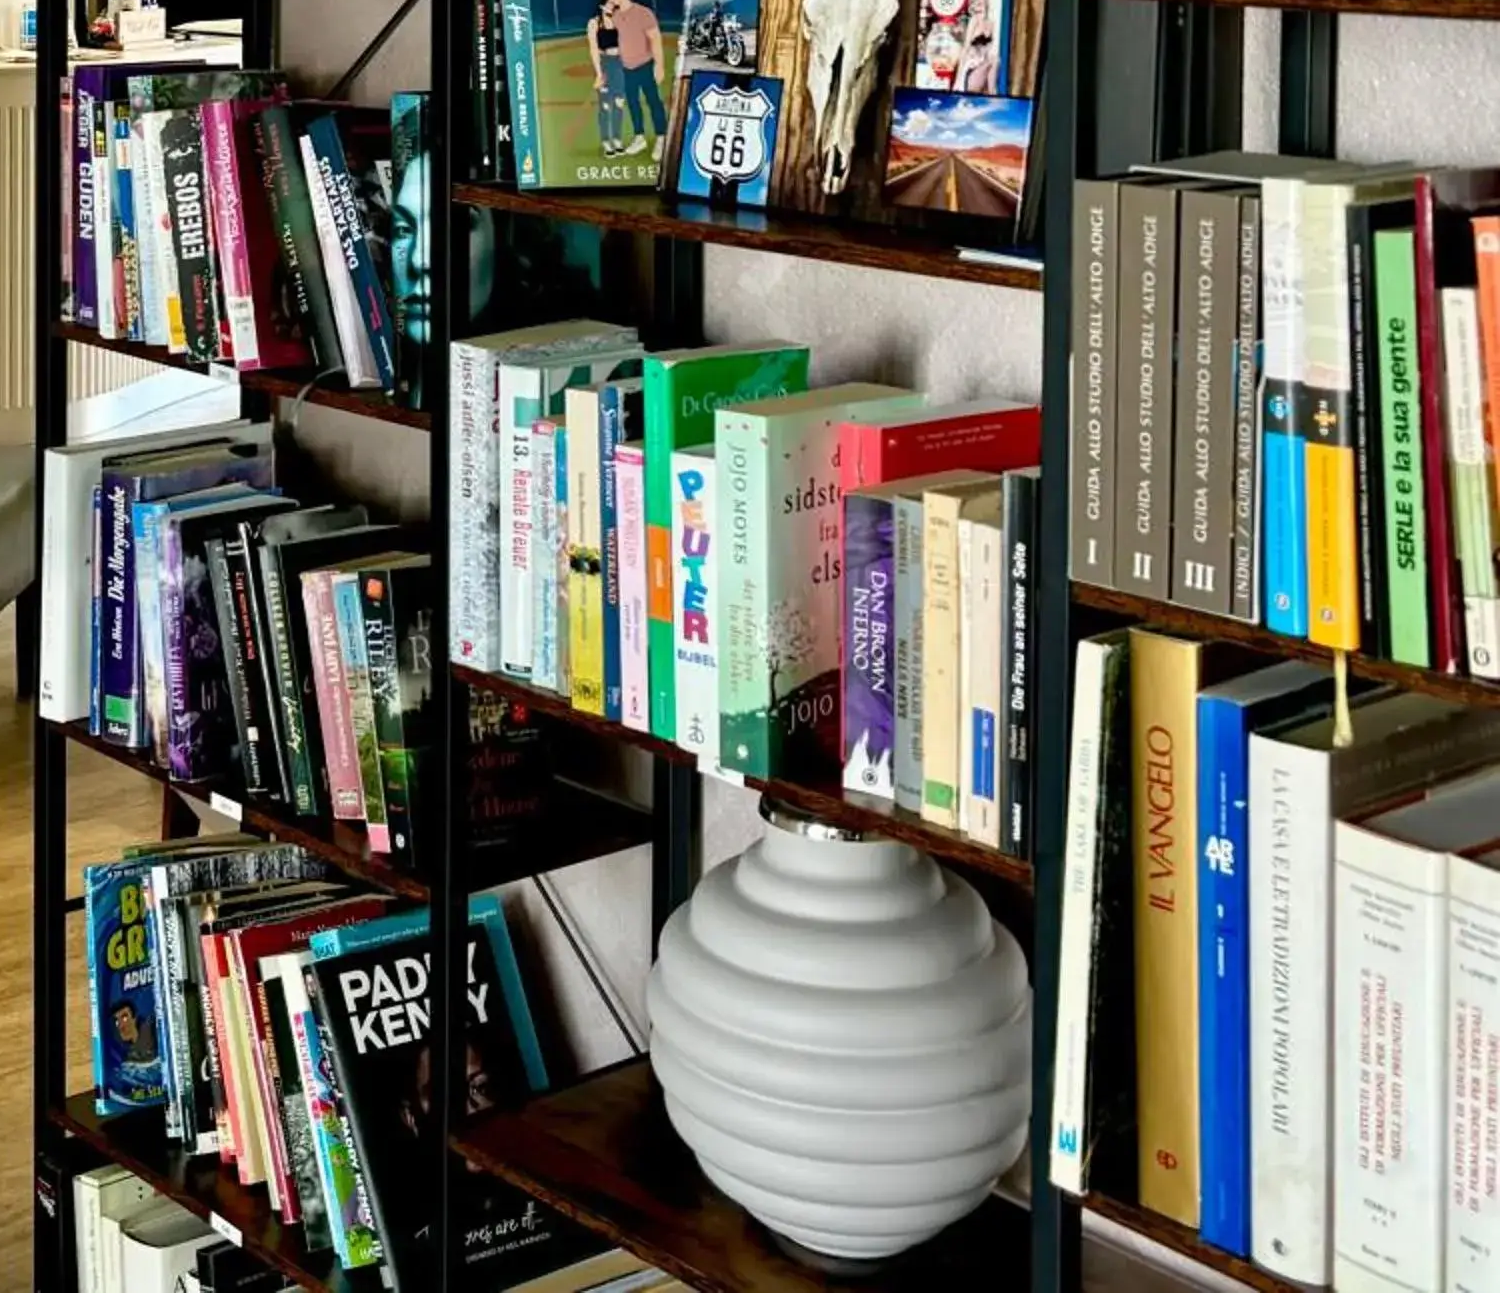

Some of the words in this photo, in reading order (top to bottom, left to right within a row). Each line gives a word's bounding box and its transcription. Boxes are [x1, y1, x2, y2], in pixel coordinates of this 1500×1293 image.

[514, 61, 527, 100] GRACE
[576, 166, 632, 181] GRACE
[710, 133, 746, 169] 66
[79, 162, 93, 240] GUDEN
[173, 171, 206, 260] EREBOS
[318, 155, 348, 238] TARTARUS
[335, 171, 363, 243] PROJEKT
[342, 237, 360, 270] DAS
[1090, 204, 1105, 258] ADIGE
[1143, 214, 1158, 267] ADIGE
[1199, 217, 1215, 271] ADIGE
[1241, 222, 1254, 271] ADIGE
[1089, 260, 1104, 348] DELL'ALTO
[1141, 270, 1157, 359] DELL'ALTO
[1197, 274, 1213, 365] DELL'ALTO
[1240, 273, 1254, 356] DELL'ALTO
[459, 353, 477, 397] jussi
[1387, 316, 1412, 395] gente
[1089, 352, 1103, 415] STUDIO
[1140, 363, 1155, 427] STUDIO
[1196, 368, 1211, 434] STUDIO
[1239, 359, 1254, 420] STUDIO
[1088, 418, 1102, 461] ALLO
[1238, 422, 1253, 464] ALLO
[1393, 400, 1411, 444] sua
[512, 434, 530, 462] 13.
[725, 443, 747, 493] JOJO
[1139, 430, 1154, 474] ALLO
[1195, 438, 1210, 482] ALLO
[1392, 450, 1412, 471] la
[1086, 466, 1102, 521] GUIDA
[1138, 479, 1153, 533] GUIDA
[1236, 467, 1251, 519] GUIDA
[1397, 478, 1412, 495] e
[107, 485, 130, 576] Morgengabe
[731, 498, 749, 565] MOYES
[1193, 487, 1209, 543] GUIDA
[1394, 500, 1416, 571] SERLE
[677, 469, 711, 645] PEUTER
[1011, 541, 1027, 580] Seite
[1133, 552, 1153, 581] II
[1184, 559, 1215, 592] III
[1235, 545, 1250, 599] INDICI
[107, 576, 125, 603] Die
[870, 570, 888, 614] DAN
[1013, 584, 1027, 629] seiner
[321, 613, 339, 647] JANE
[852, 587, 871, 670] INFERNO
[1014, 630, 1026, 650] an
[325, 645, 341, 684] LADY
[364, 618, 389, 701] RILEY
[870, 619, 888, 693] BROWN
[1012, 652, 1026, 685] Frau
[1011, 688, 1026, 711] Die
[1145, 724, 1174, 879] VANGELO
[1270, 768, 1291, 794] LA
[1270, 799, 1291, 850] CASA
[1270, 855, 1291, 871] E
[1270, 873, 1291, 900] LE
[1147, 889, 1175, 913] IL
[1270, 903, 1291, 1024] TRADIZIONI
[1270, 1028, 1291, 1136] POPOLARI
